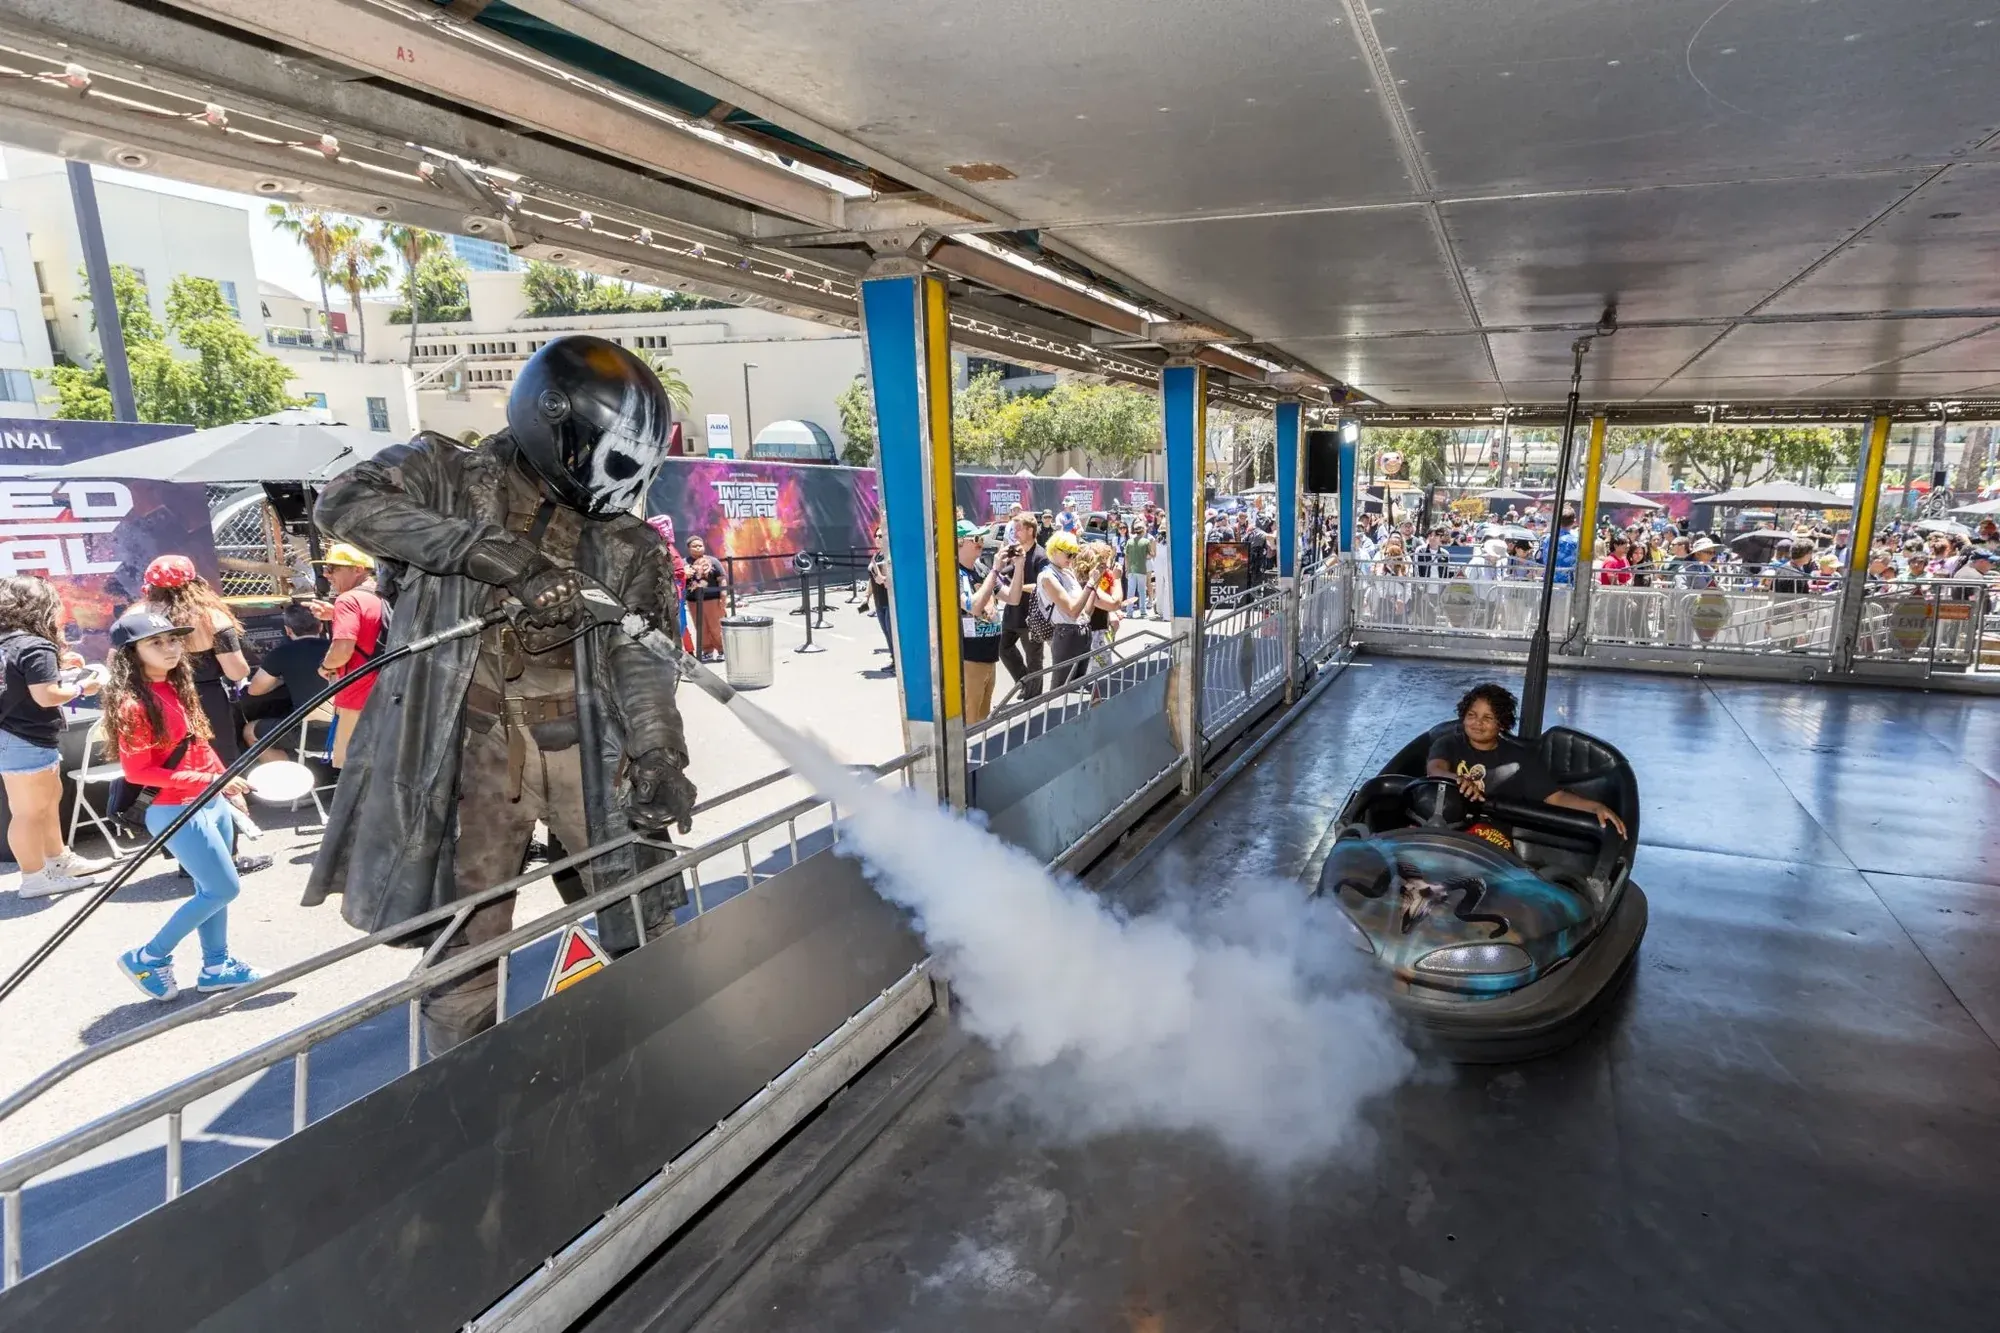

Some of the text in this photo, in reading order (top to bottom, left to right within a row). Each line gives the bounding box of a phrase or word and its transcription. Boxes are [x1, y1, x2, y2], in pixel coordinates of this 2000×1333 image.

[396, 46, 415, 63] A3
[710, 481, 779, 500] TWISTED
[718, 500, 777, 519] METAL
[1210, 585, 1239, 595] EXIT
[1209, 595, 1243, 605] ONLY
